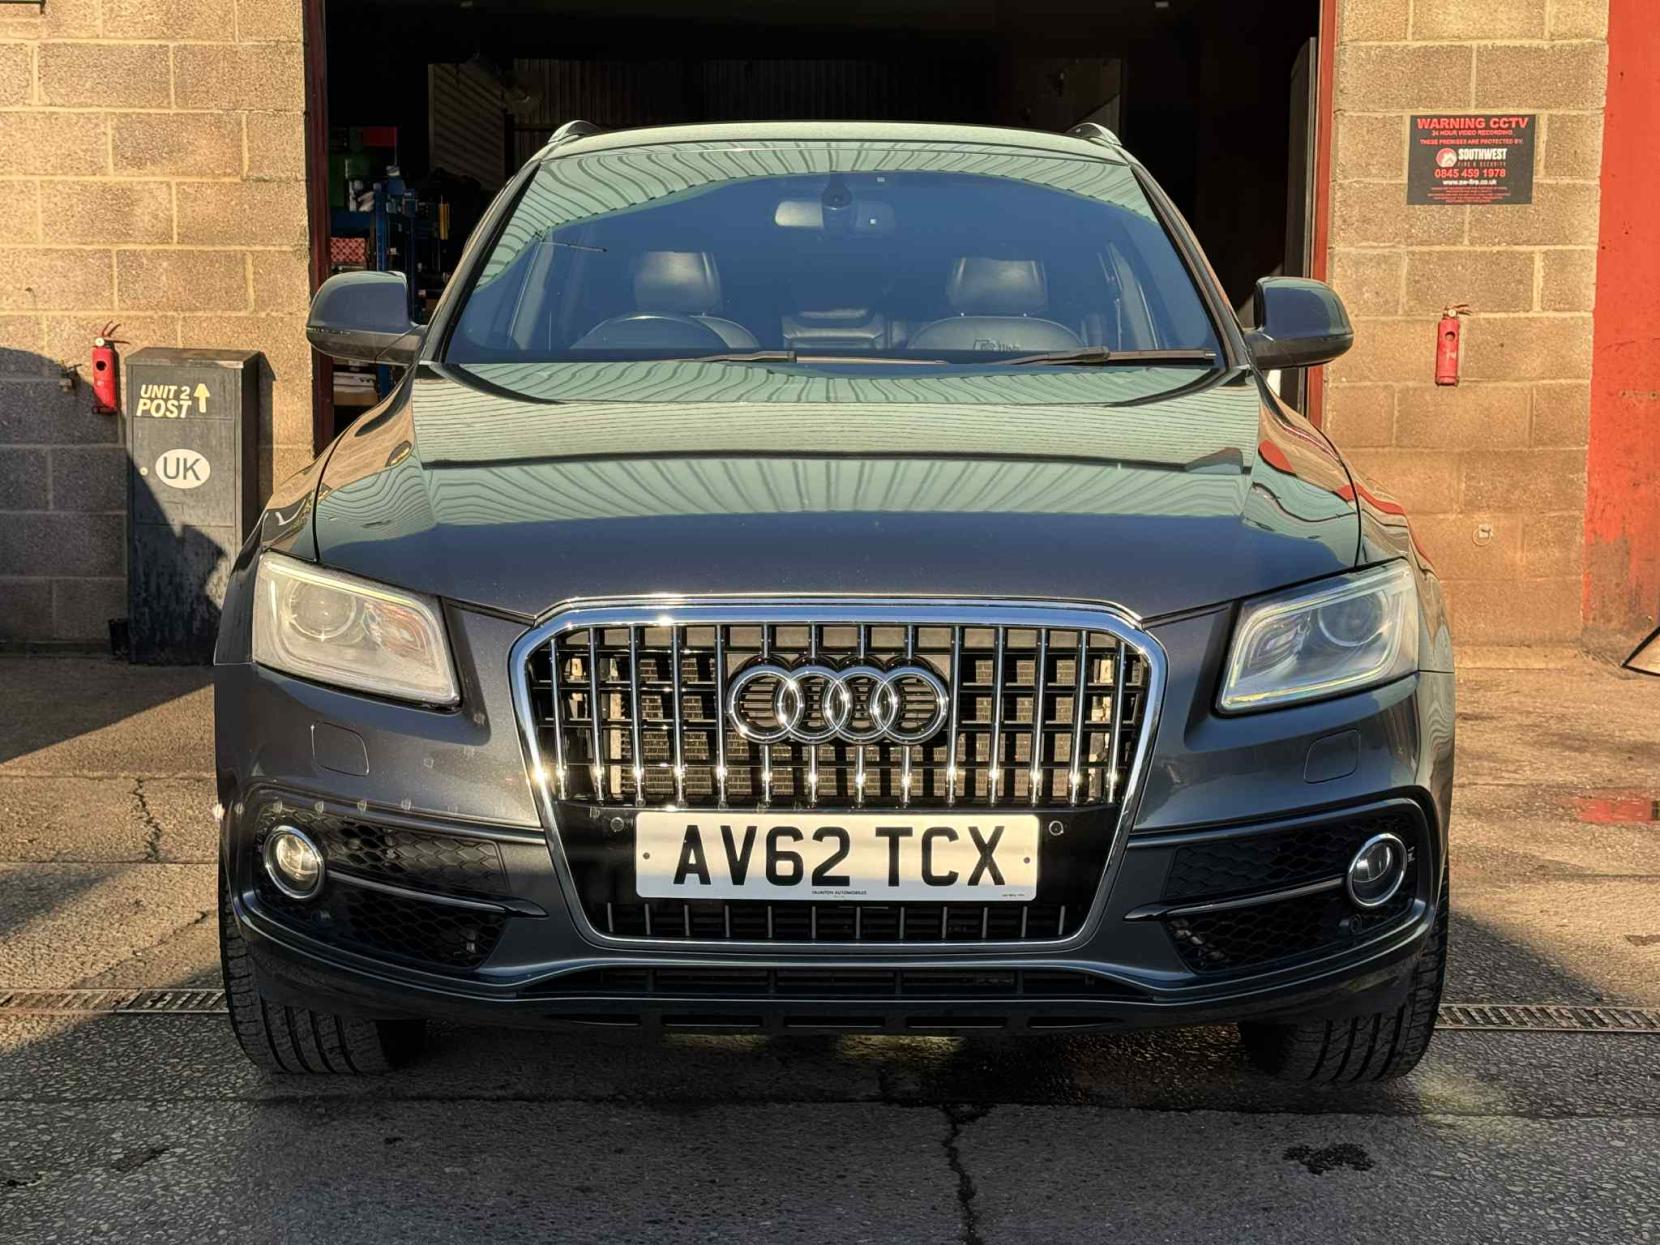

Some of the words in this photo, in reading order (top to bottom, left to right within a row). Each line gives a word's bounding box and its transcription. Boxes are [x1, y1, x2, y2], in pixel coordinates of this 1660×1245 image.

[1417, 118, 1485, 129] WARNING
[1490, 117, 1528, 128] CCTV
[1458, 148, 1508, 160] SOUTHWEST
[1434, 168, 1459, 178] 0845
[1461, 168, 1480, 178] 459
[1483, 168, 1506, 177] 1978
[140, 384, 177, 399] UNIT
[180, 386, 191, 400] 2
[136, 399, 192, 418] POST
[163, 457, 202, 481] UK
[673, 824, 851, 887] AV62
[875, 825, 1006, 887] TCX
